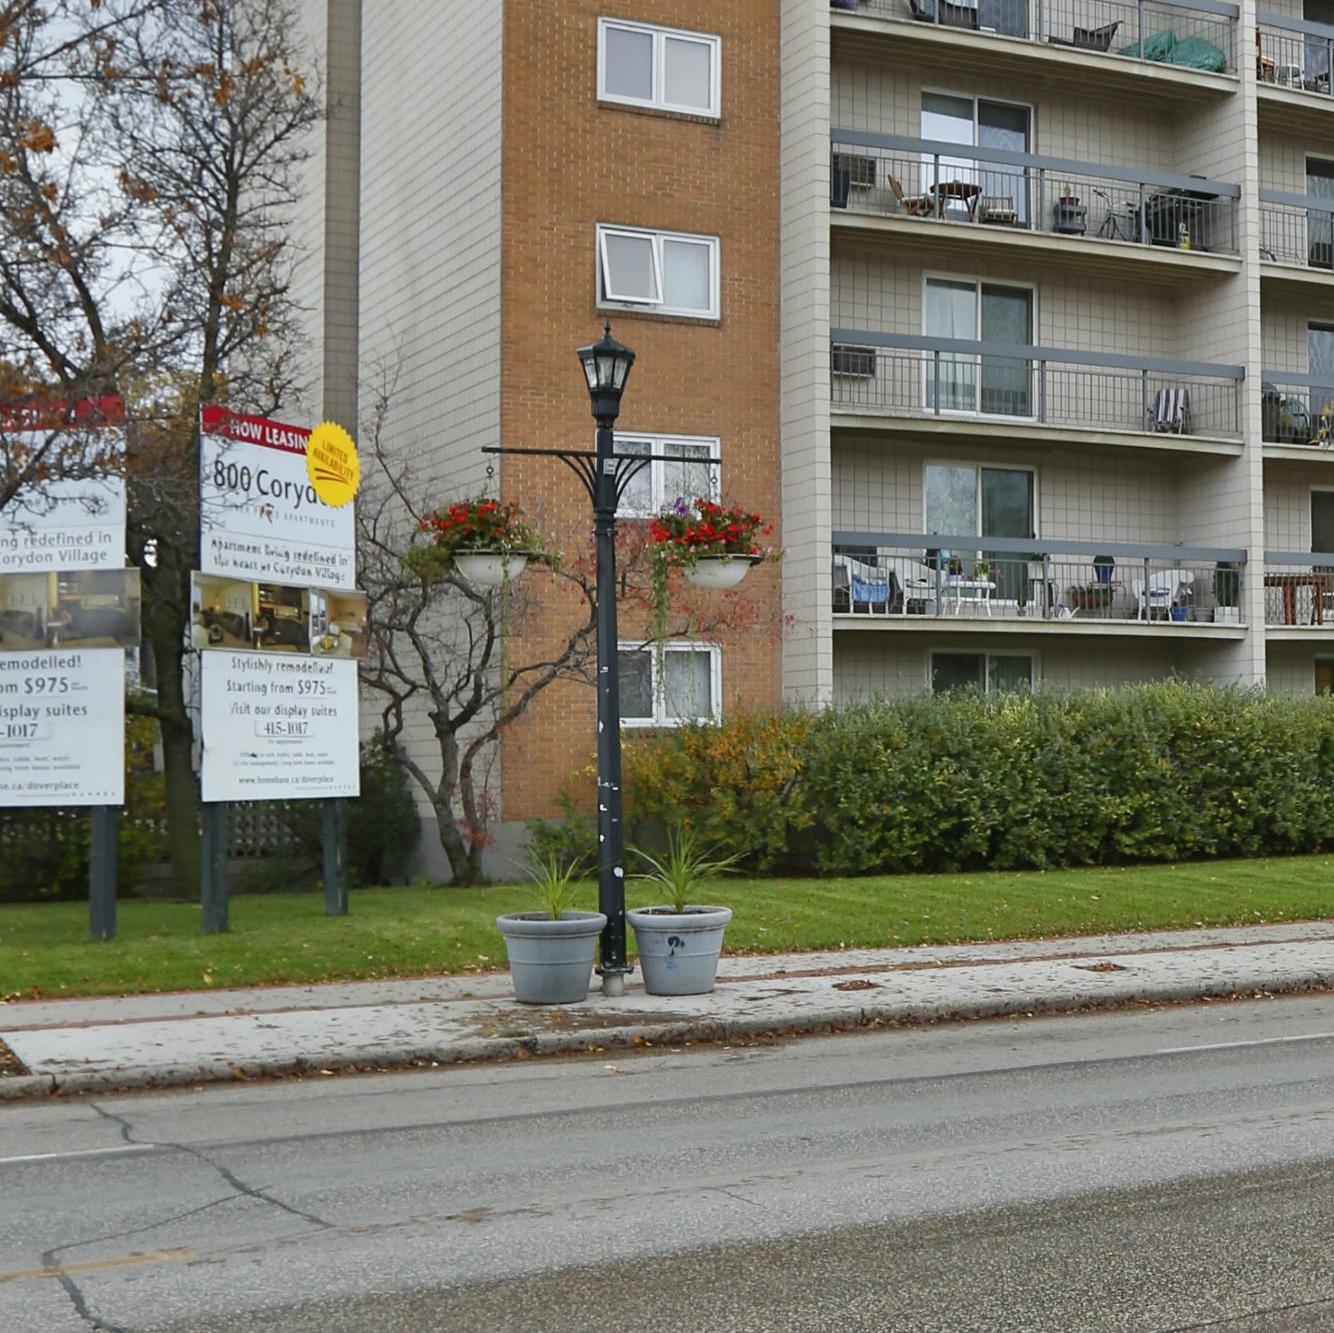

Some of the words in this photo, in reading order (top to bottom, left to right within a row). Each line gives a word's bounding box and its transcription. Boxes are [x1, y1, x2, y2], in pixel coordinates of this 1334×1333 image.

[230, 419, 262, 440] NOW
[265, 426, 308, 449] LEASIN
[322, 440, 348, 464] LIMITED
[214, 460, 250, 492] 800
[256, 469, 327, 509] Coryd
[24, 533, 93, 546] redefined
[98, 531, 112, 543] in
[0, 551, 53, 568] orydon
[59, 549, 108, 564] Village
[211, 538, 261, 556] Apartment
[264, 544, 290, 562] living
[293, 551, 337, 564] redefined
[273, 562, 312, 578] Corydon
[0, 655, 81, 670] emodelled!
[232, 657, 273, 674] Stylishly
[24, 677, 69, 694] $975
[227, 679, 268, 696] Starting
[270, 682, 294, 694] from
[298, 680, 326, 695] $975
[0, 704, 40, 721] isplay
[46, 703, 88, 717] suites
[254, 706, 271, 715] our
[274, 704, 308, 719] display
[311, 705, 337, 716] suites
[264, 722, 308, 735] 415-1017
